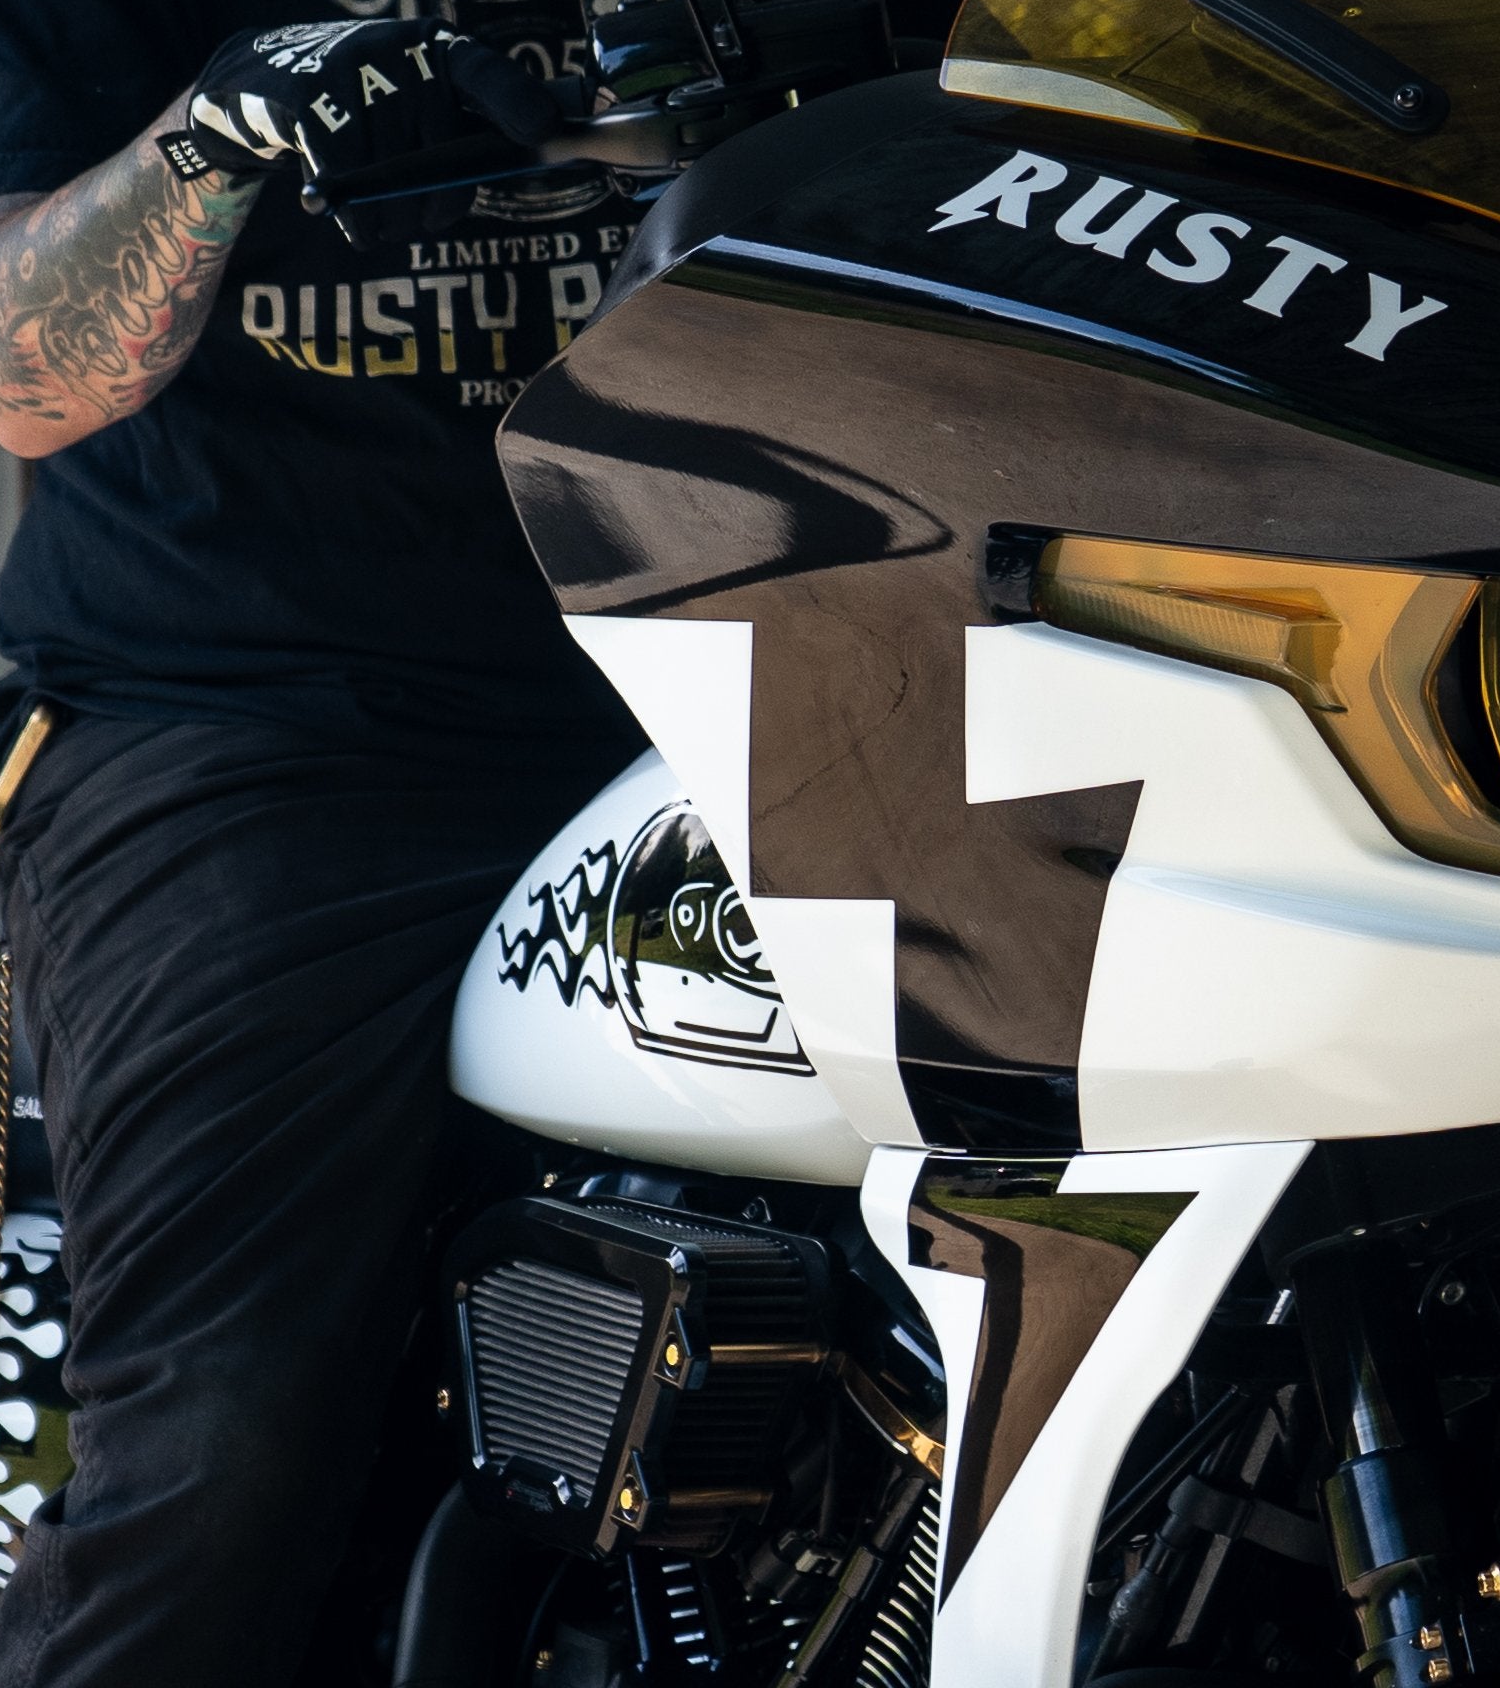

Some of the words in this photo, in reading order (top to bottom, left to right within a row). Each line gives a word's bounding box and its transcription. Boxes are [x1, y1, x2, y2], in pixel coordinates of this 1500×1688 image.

[309, 41, 435, 134] EAT
[167, 142, 194, 174] RIDE
[409, 231, 581, 271] LIMITED
[927, 149, 1449, 362] RUSTY
[241, 271, 519, 379] RUSTY
